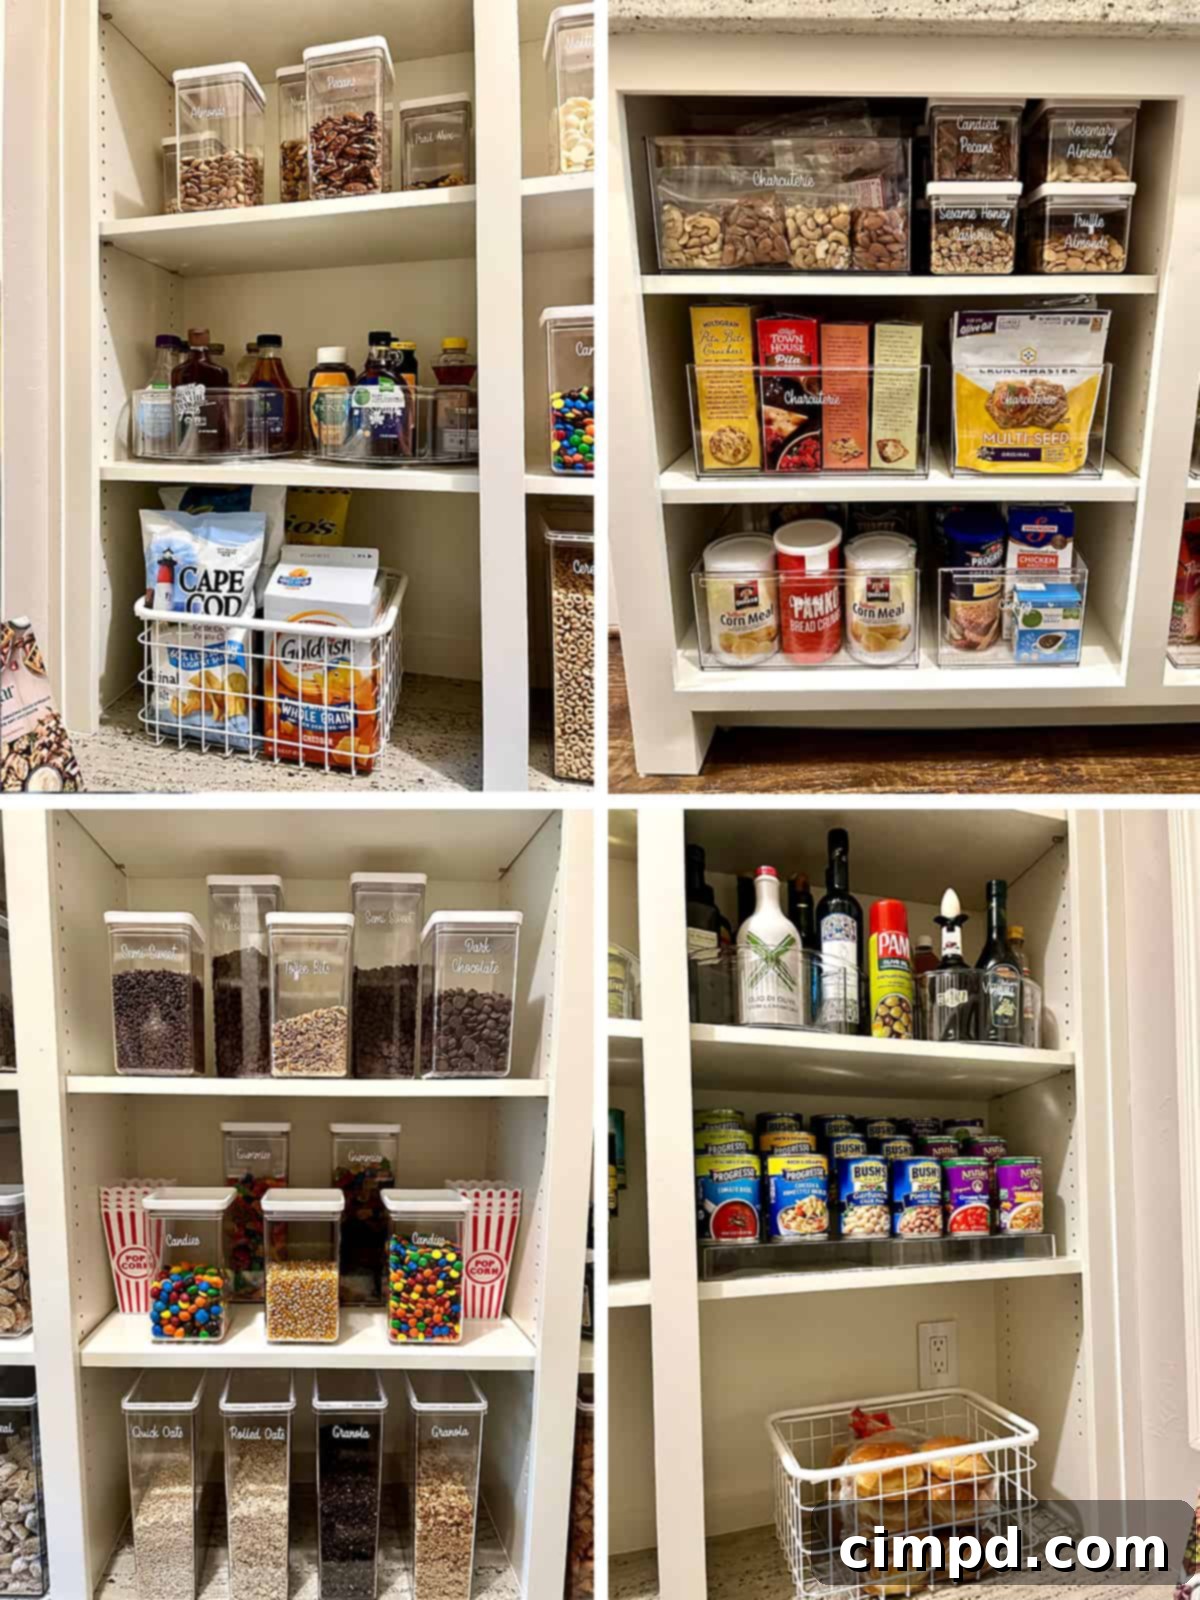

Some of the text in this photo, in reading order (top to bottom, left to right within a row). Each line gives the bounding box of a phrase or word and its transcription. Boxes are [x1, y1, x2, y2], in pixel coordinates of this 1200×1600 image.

[956, 114, 1000, 131] Candied
[1065, 119, 1118, 146] Rosemary
[959, 135, 994, 153] Pecans
[1065, 143, 1114, 160] Almonds
[752, 168, 816, 188] Charcuterie
[939, 202, 1011, 228] Sesame Honey
[1072, 212, 1105, 235] Truffle
[1064, 234, 1110, 251] Almonds
[959, 324, 981, 335] Olive
[769, 333, 805, 344] TOWN
[770, 343, 806, 354] HOUSE
[774, 353, 802, 366] Pita
[784, 388, 841, 406] Charcuterie
[982, 432, 1070, 445] MULTI SEED
[1018, 555, 1057, 564] CHICKEN
[179, 566, 245, 594] CAPE
[186, 593, 243, 618] COD
[793, 586, 839, 619] PANKO
[852, 602, 905, 619] Corn Meal
[720, 614, 746, 626] Corn
[747, 603, 774, 625] Meal
[790, 619, 816, 633] BREAD
[281, 700, 317, 723] WHOLE
[320, 709, 354, 725] GRAIN
[463, 936, 492, 953] Dark
[878, 932, 911, 959] PAM
[451, 956, 501, 975] Chocolate
[712, 1165, 756, 1181] PROGRESSO
[165, 1233, 200, 1247] Candies
[125, 1254, 146, 1262] POP
[469, 1267, 499, 1275] CORN
[131, 1425, 184, 1439] Quick Oats
[228, 1425, 286, 1441] Rolled Oats
[331, 1425, 371, 1440] Granola
[431, 1425, 470, 1438] Granola
